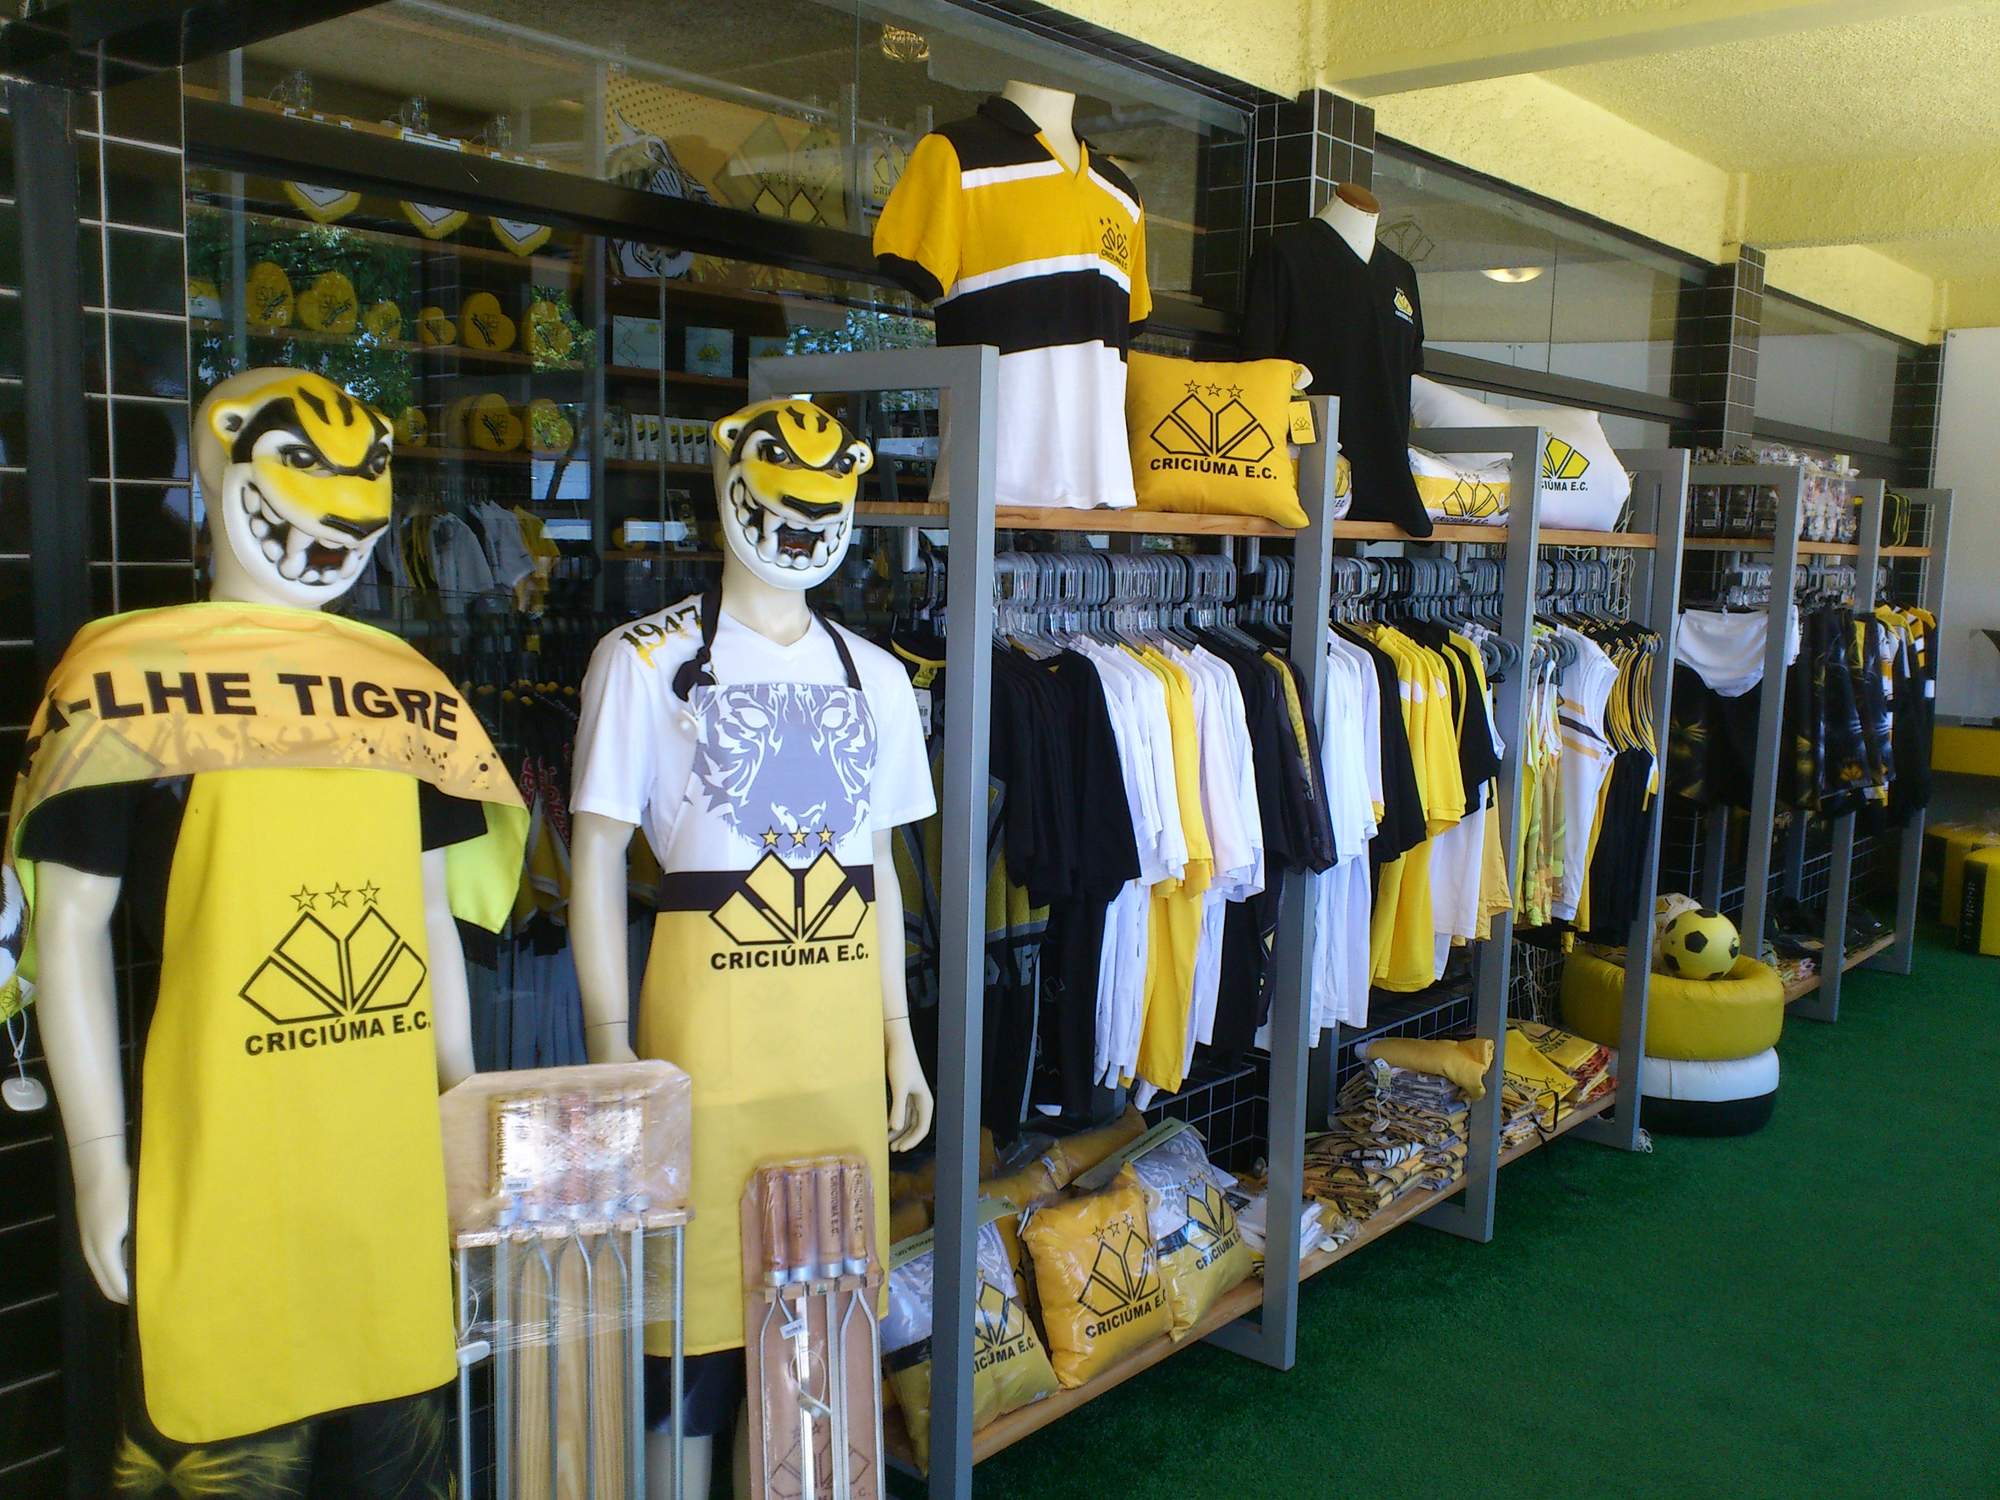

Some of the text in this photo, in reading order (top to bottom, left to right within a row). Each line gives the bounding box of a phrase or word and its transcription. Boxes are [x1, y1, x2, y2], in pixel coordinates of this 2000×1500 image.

[1150, 457, 1278, 481] CRICIÚMA E.C.
[1570, 481, 1589, 492] E.C.
[620, 604, 703, 662] 1947
[277, 672, 459, 742] TIGRE
[710, 942, 870, 971] CRICIÚMA E.C.
[244, 1010, 432, 1057] CRICIÚMA E.C.
[1085, 1302, 1152, 1339] CRICIÚMA
